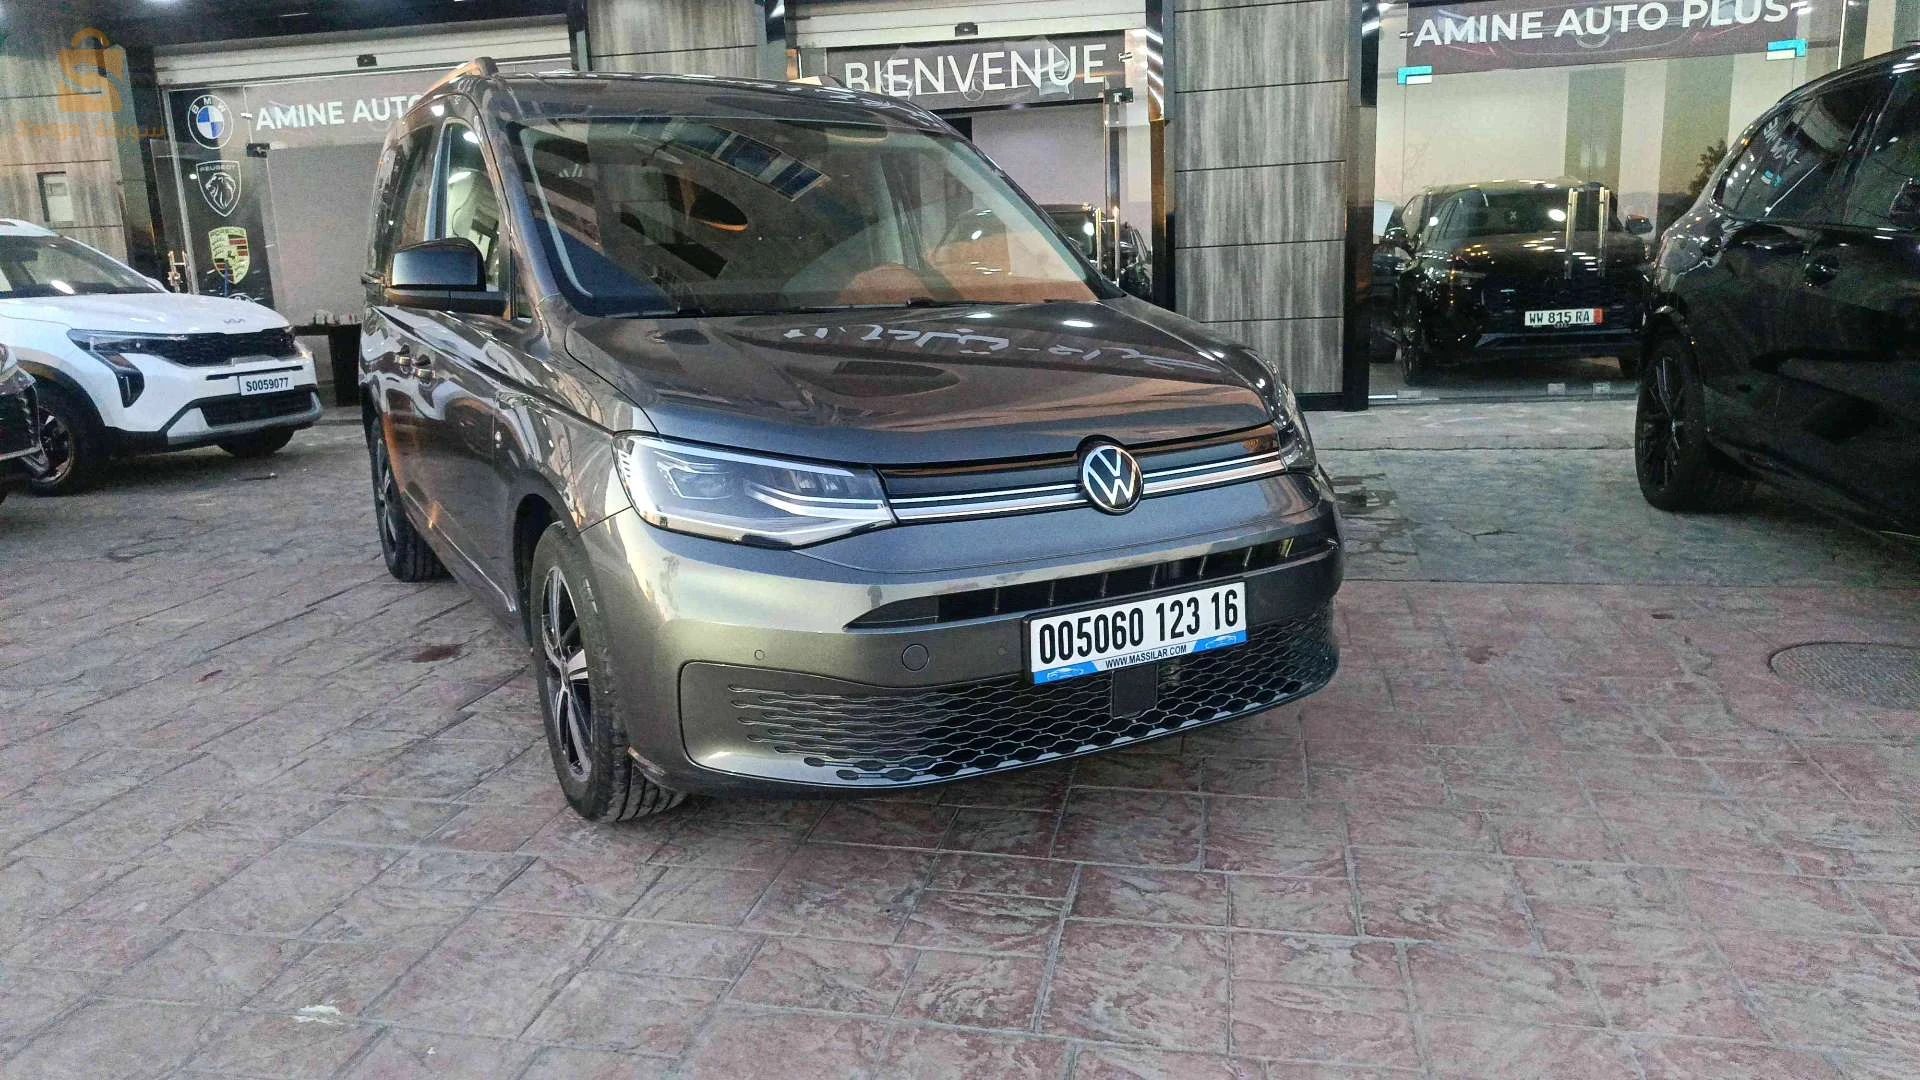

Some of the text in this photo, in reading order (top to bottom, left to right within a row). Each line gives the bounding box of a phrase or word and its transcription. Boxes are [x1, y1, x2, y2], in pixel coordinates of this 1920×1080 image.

[1413, 0, 1789, 47] AMINE AUTO PLUS
[845, 44, 1106, 97] BIENVENUE
[256, 101, 345, 131] AMINE
[1529, 311, 1590, 324] WW 815 RA
[245, 377, 289, 392] S0059077
[1039, 589, 1238, 664] 005060 123 16
[1105, 645, 1187, 668] WWW.MASSILAR.COM
